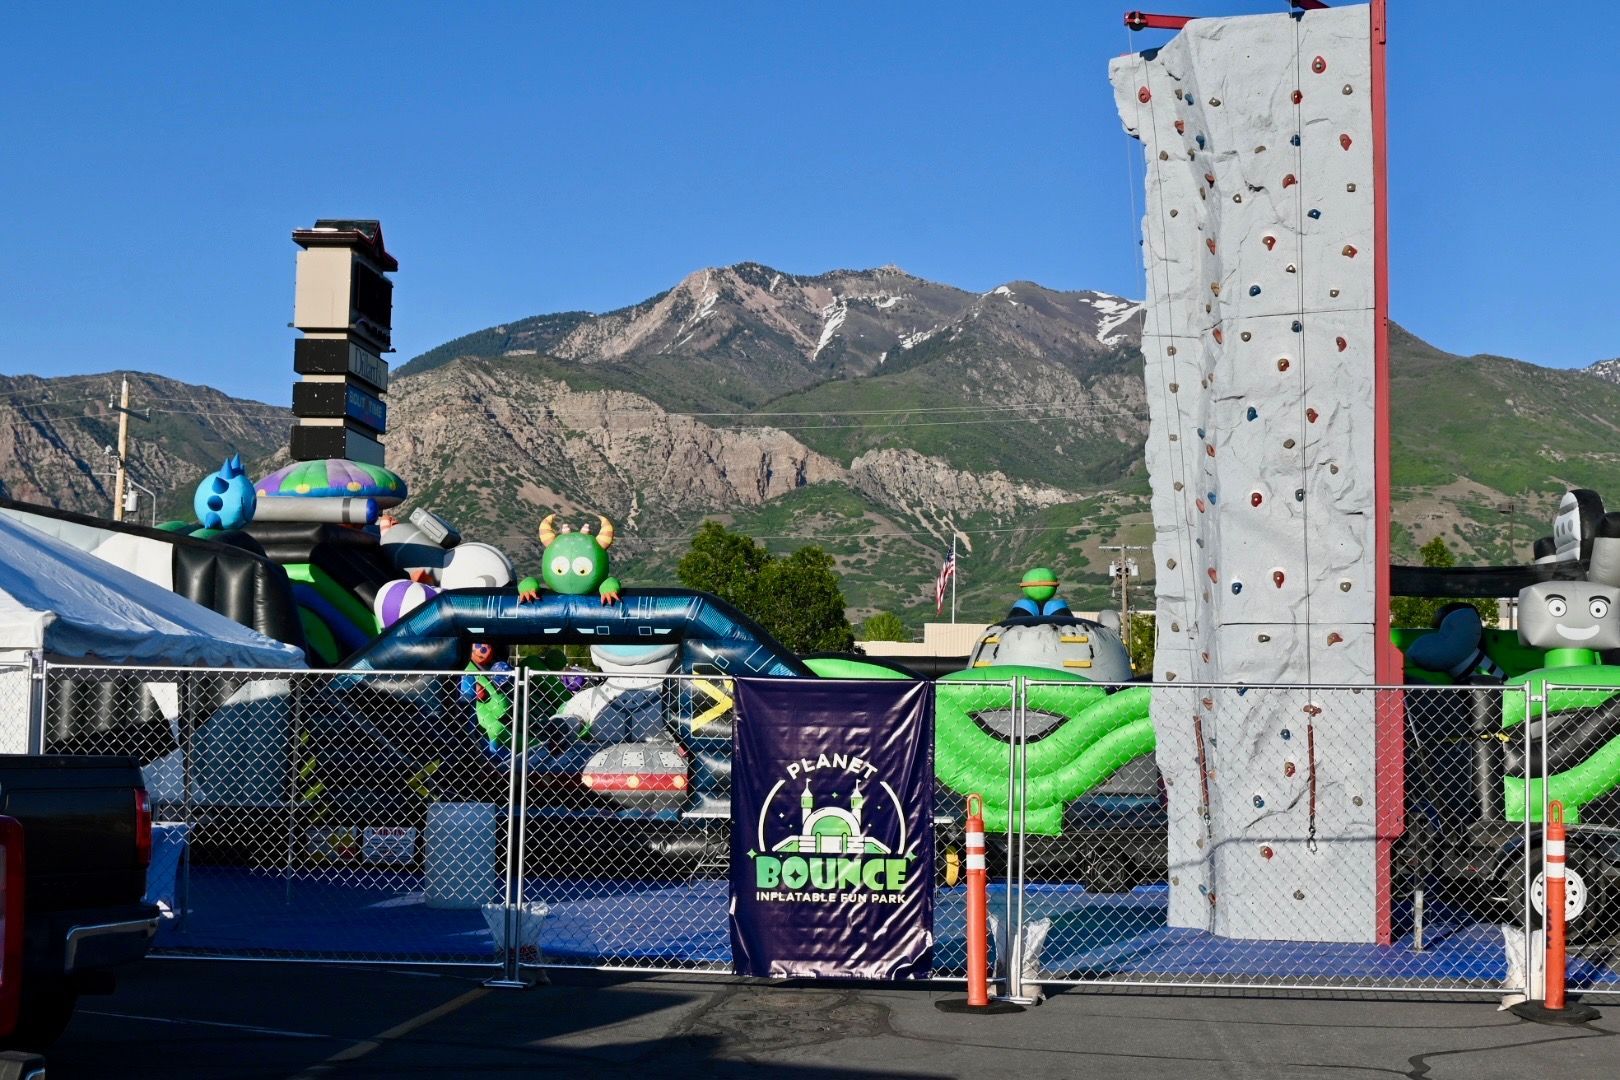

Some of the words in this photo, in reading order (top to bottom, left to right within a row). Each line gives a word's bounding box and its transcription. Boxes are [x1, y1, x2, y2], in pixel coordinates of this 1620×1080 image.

[354, 347, 382, 387] Dillard's
[786, 753, 879, 780] PLANET
[755, 855, 907, 890] BOUNCE
[755, 891, 837, 903] INFLATABLE
[841, 893, 868, 903] FUN
[872, 893, 906, 904] PARK
